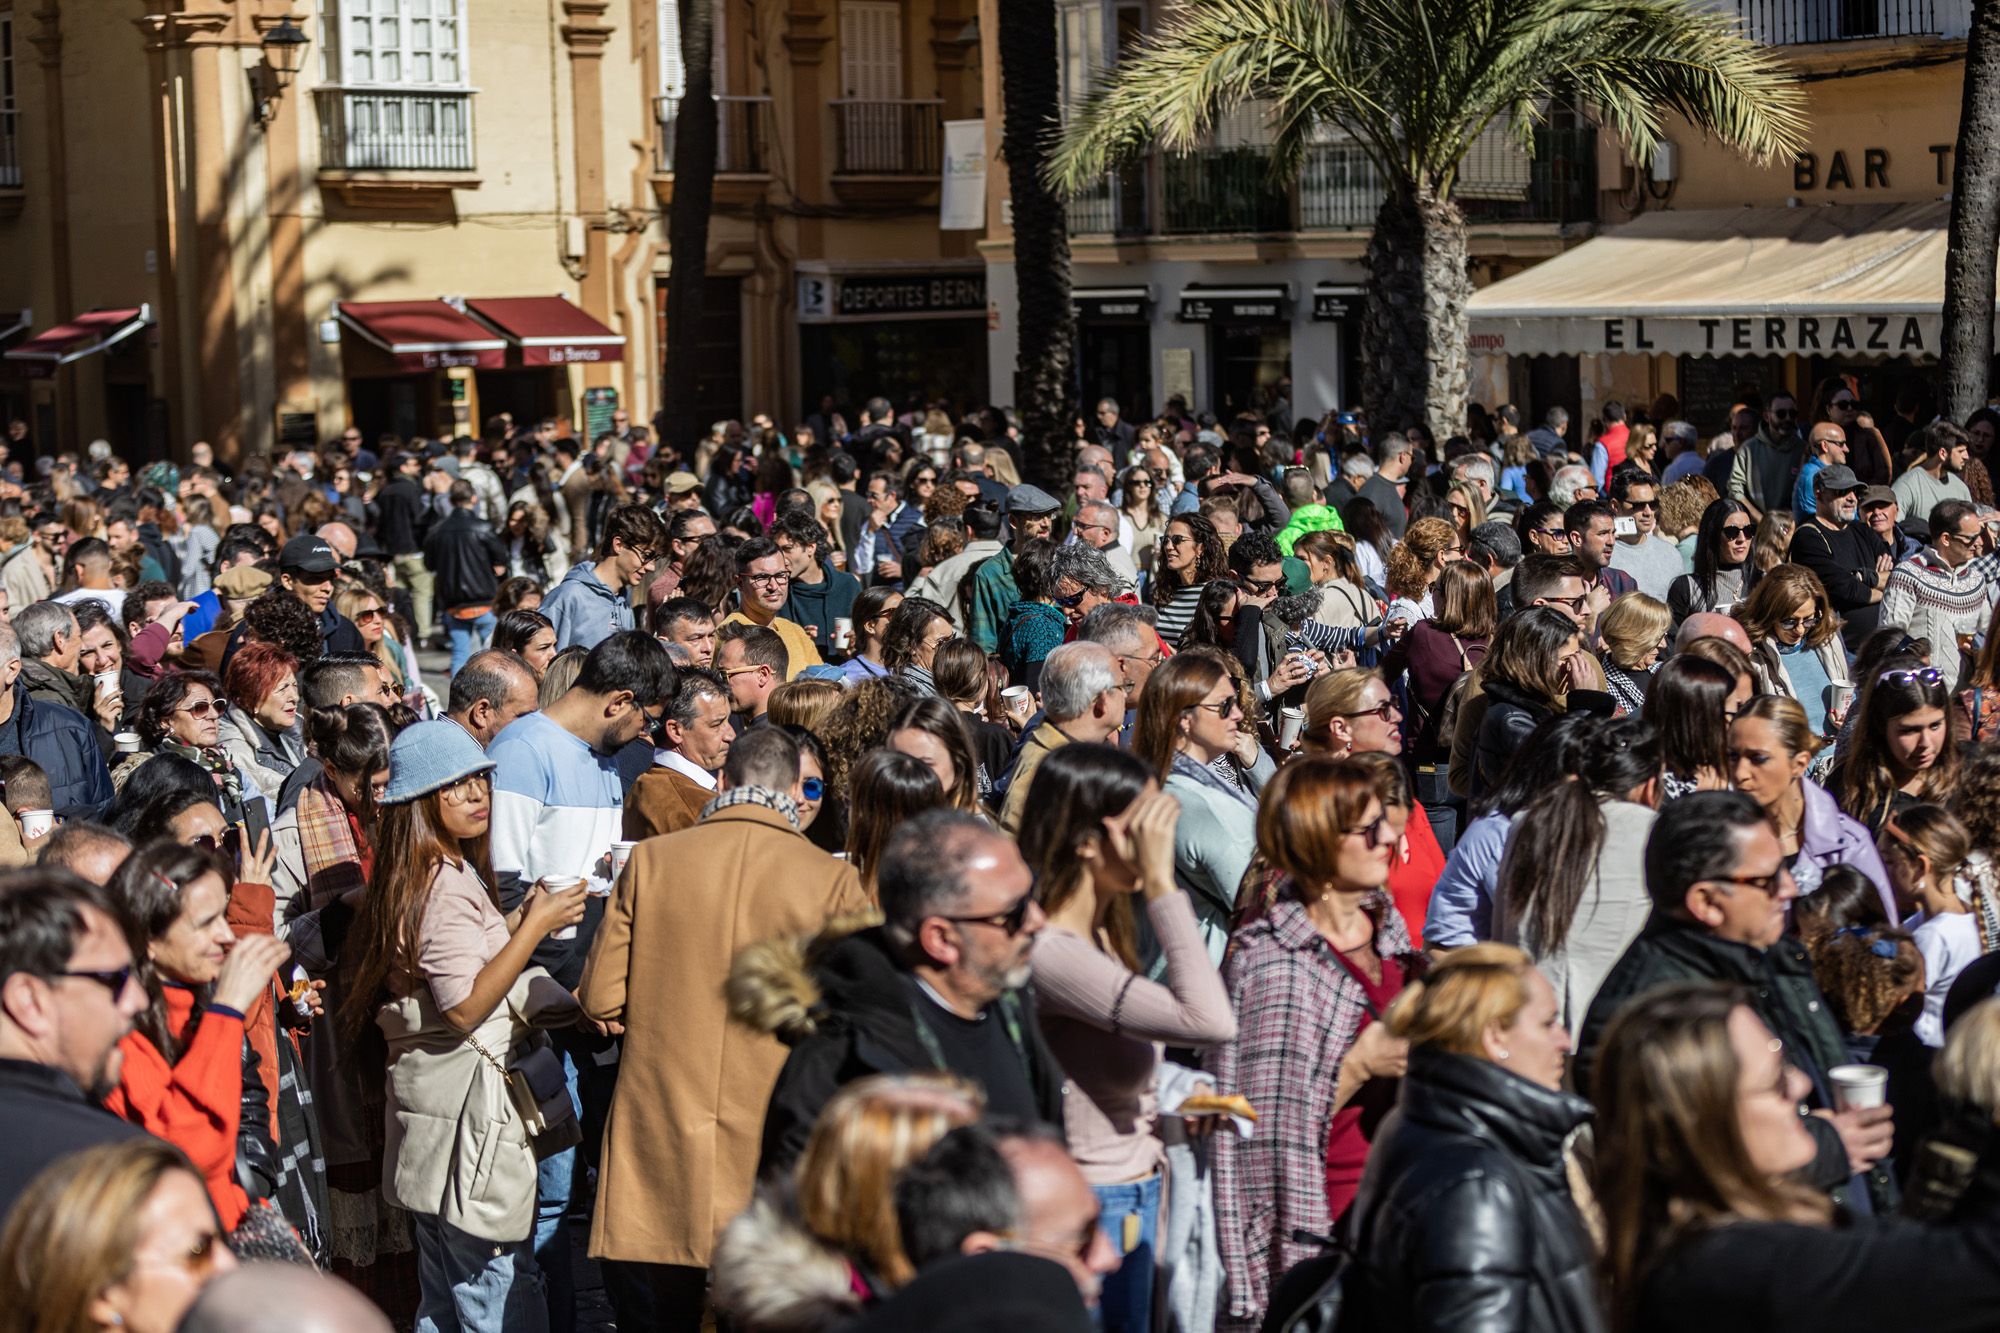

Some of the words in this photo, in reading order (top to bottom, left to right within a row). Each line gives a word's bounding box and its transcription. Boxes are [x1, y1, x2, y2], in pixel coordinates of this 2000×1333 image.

[1793, 147, 1890, 191] BAR
[843, 286, 924, 309] DEPORTES
[1604, 318, 1654, 349] EL
[1698, 316, 1924, 350] TERRAZA
